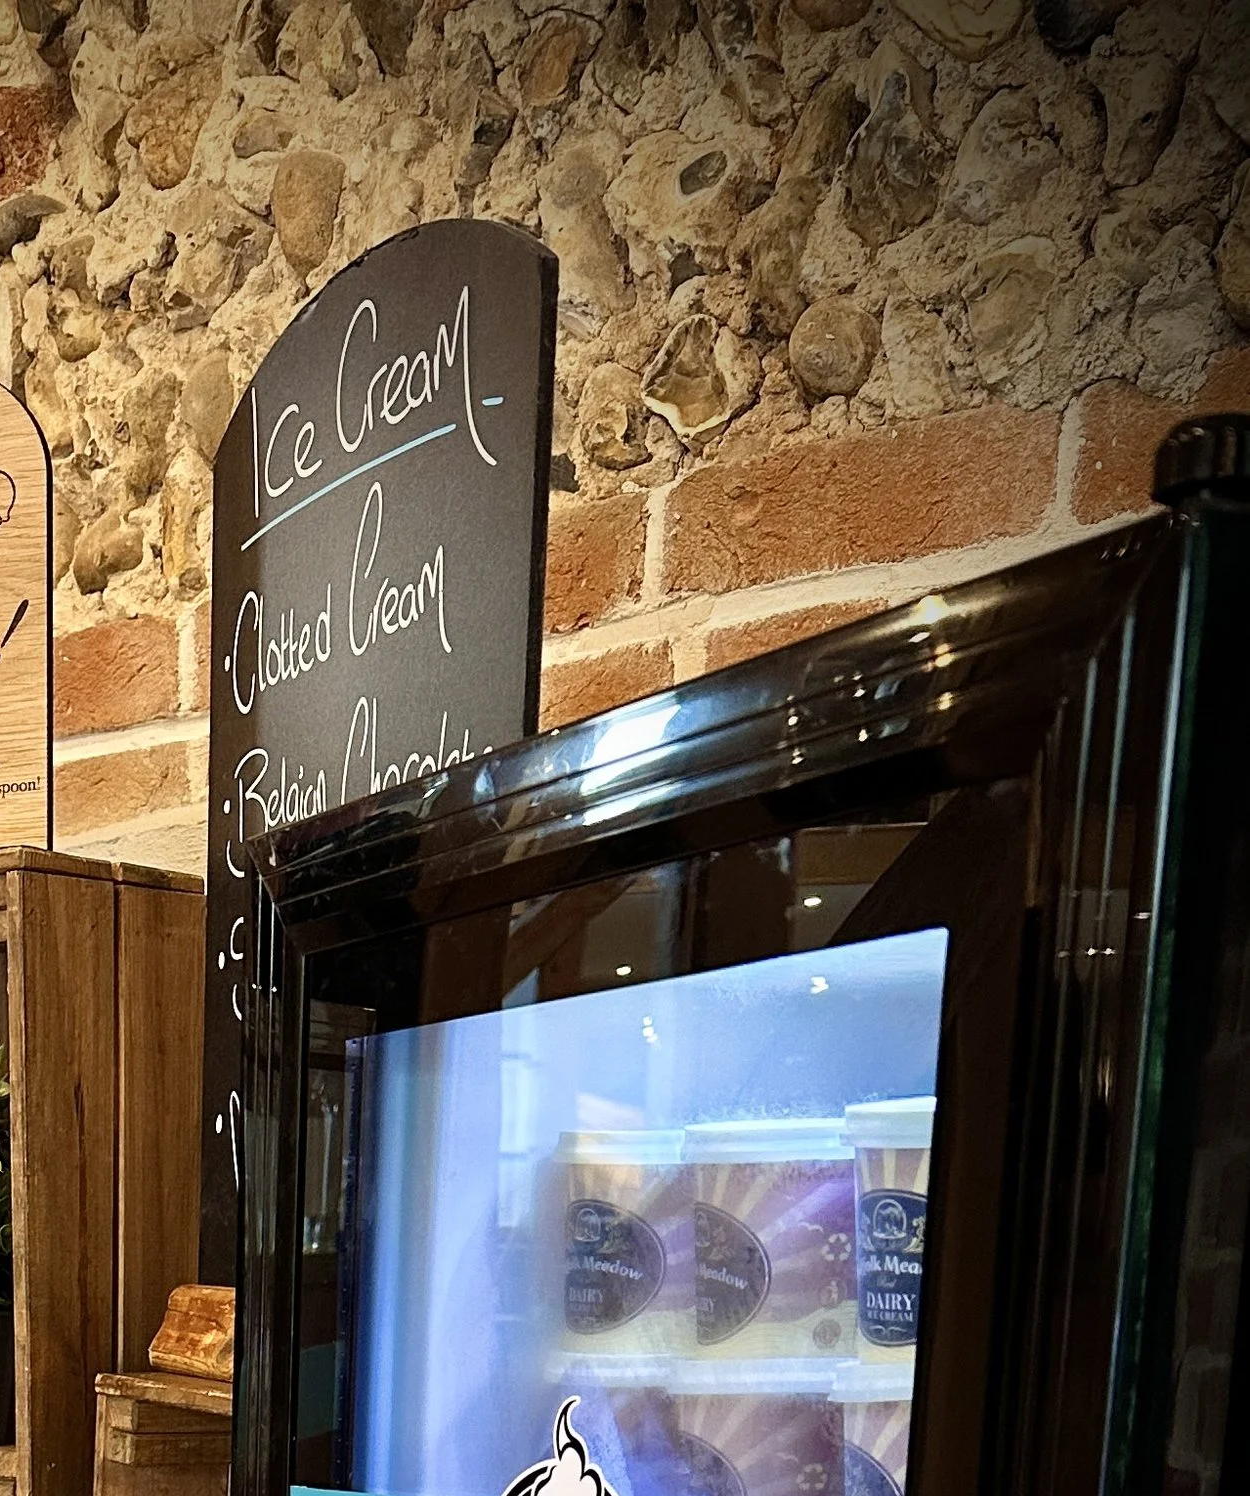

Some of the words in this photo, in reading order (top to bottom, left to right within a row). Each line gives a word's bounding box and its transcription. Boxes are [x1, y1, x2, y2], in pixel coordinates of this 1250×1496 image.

[250, 385, 323, 519] Ice
[335, 284, 498, 467] Cream
[230, 582, 332, 716] Clotted
[347, 481, 453, 658] Cream
[866, 1291, 917, 1311] DAIRY
